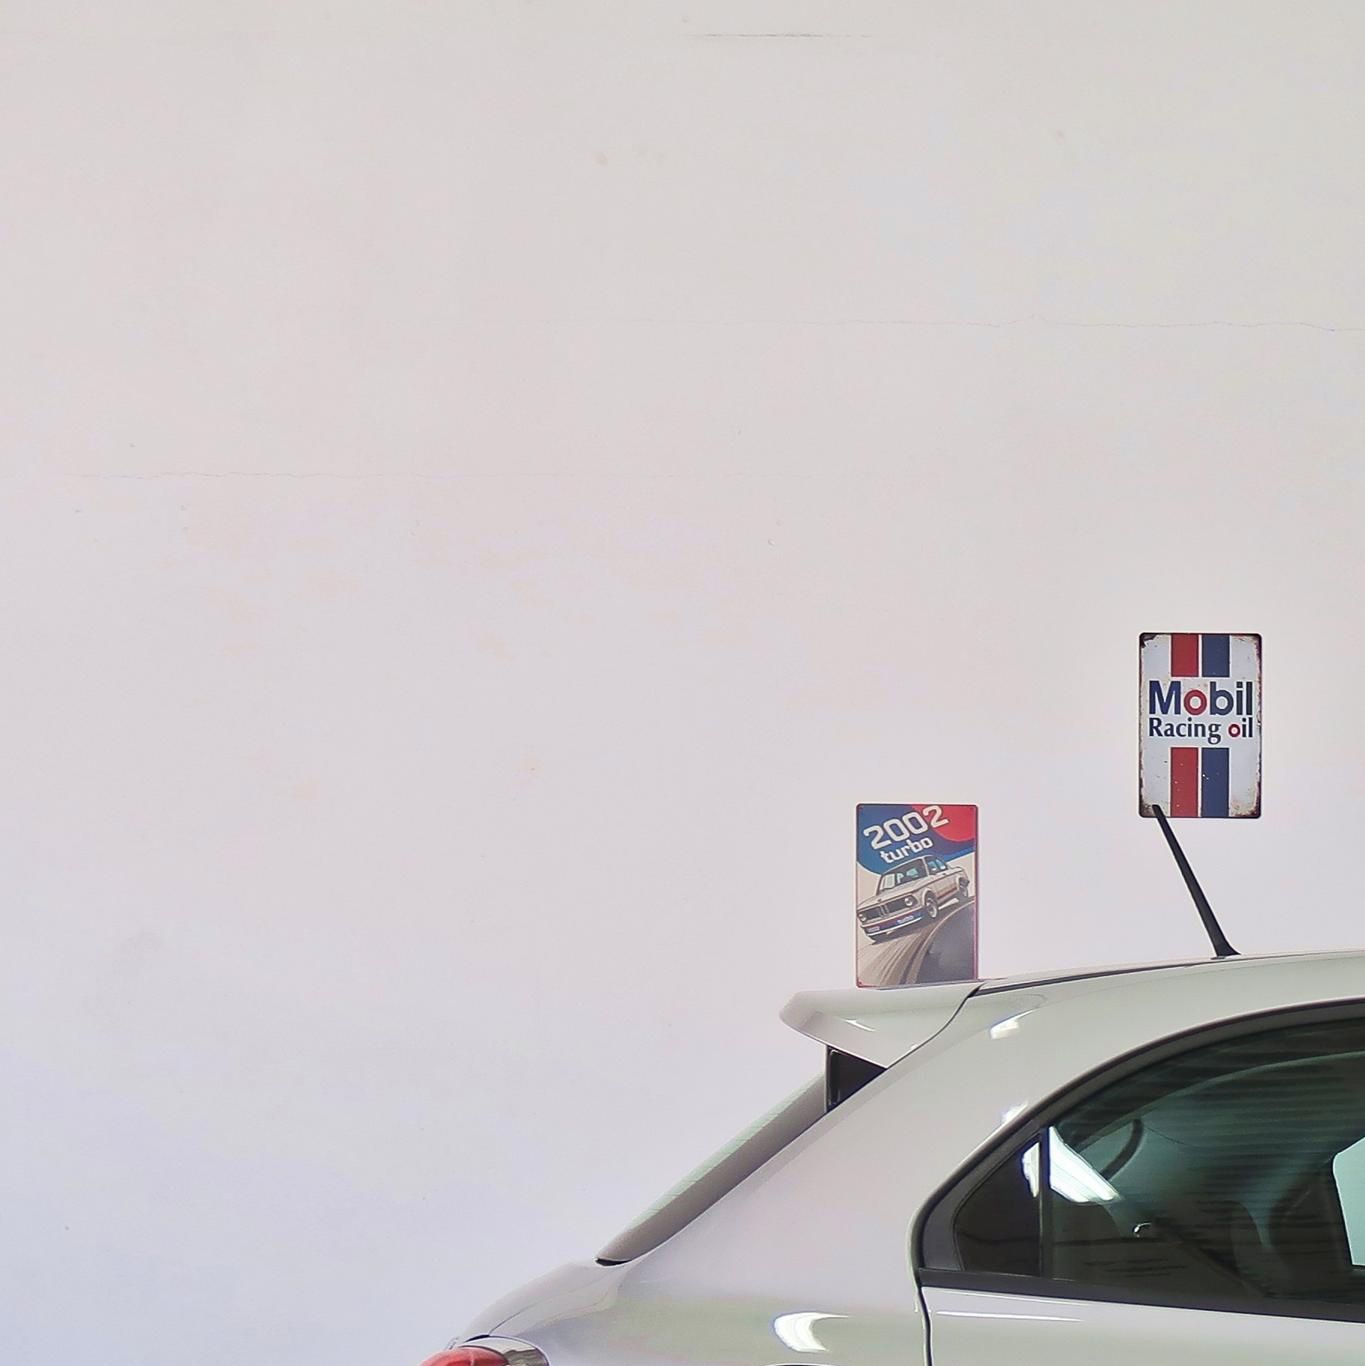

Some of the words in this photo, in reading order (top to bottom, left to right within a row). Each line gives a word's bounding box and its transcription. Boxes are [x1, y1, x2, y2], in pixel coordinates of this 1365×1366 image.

[1149, 680, 1253, 716] Mobil
[1149, 717, 1222, 745] Racing
[1228, 717, 1253, 738] oil
[863, 805, 950, 850] 2002
[880, 837, 934, 863] turbo
